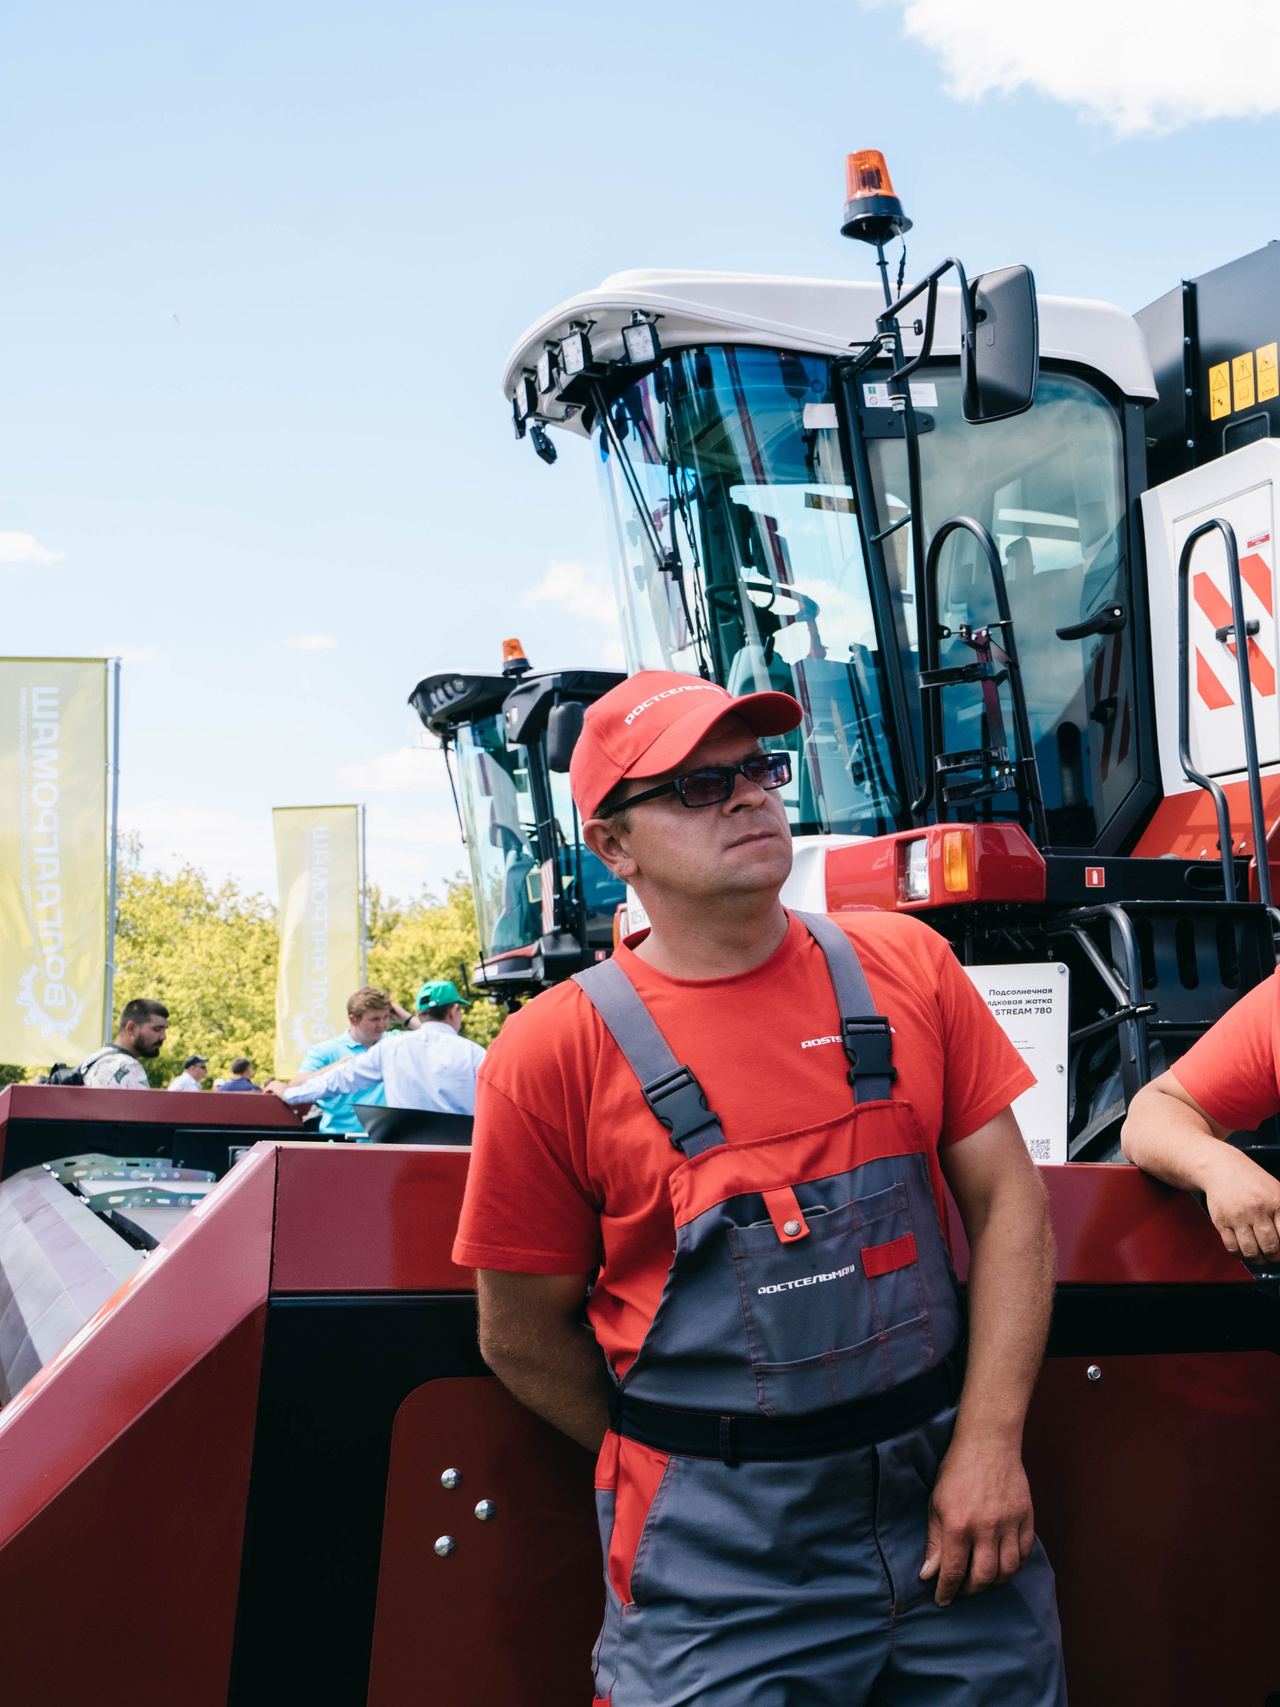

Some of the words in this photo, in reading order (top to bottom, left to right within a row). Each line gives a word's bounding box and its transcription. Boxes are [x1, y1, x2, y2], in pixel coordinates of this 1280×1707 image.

[624, 685, 726, 726] РОСТСЕЛЬМ
[988, 988, 1053, 996] Подсолнечная
[994, 1008, 1032, 1016] STREAM
[1034, 1006, 1053, 1014] 780
[757, 1264, 856, 1295] РОСТСЕЛЬМАШ
